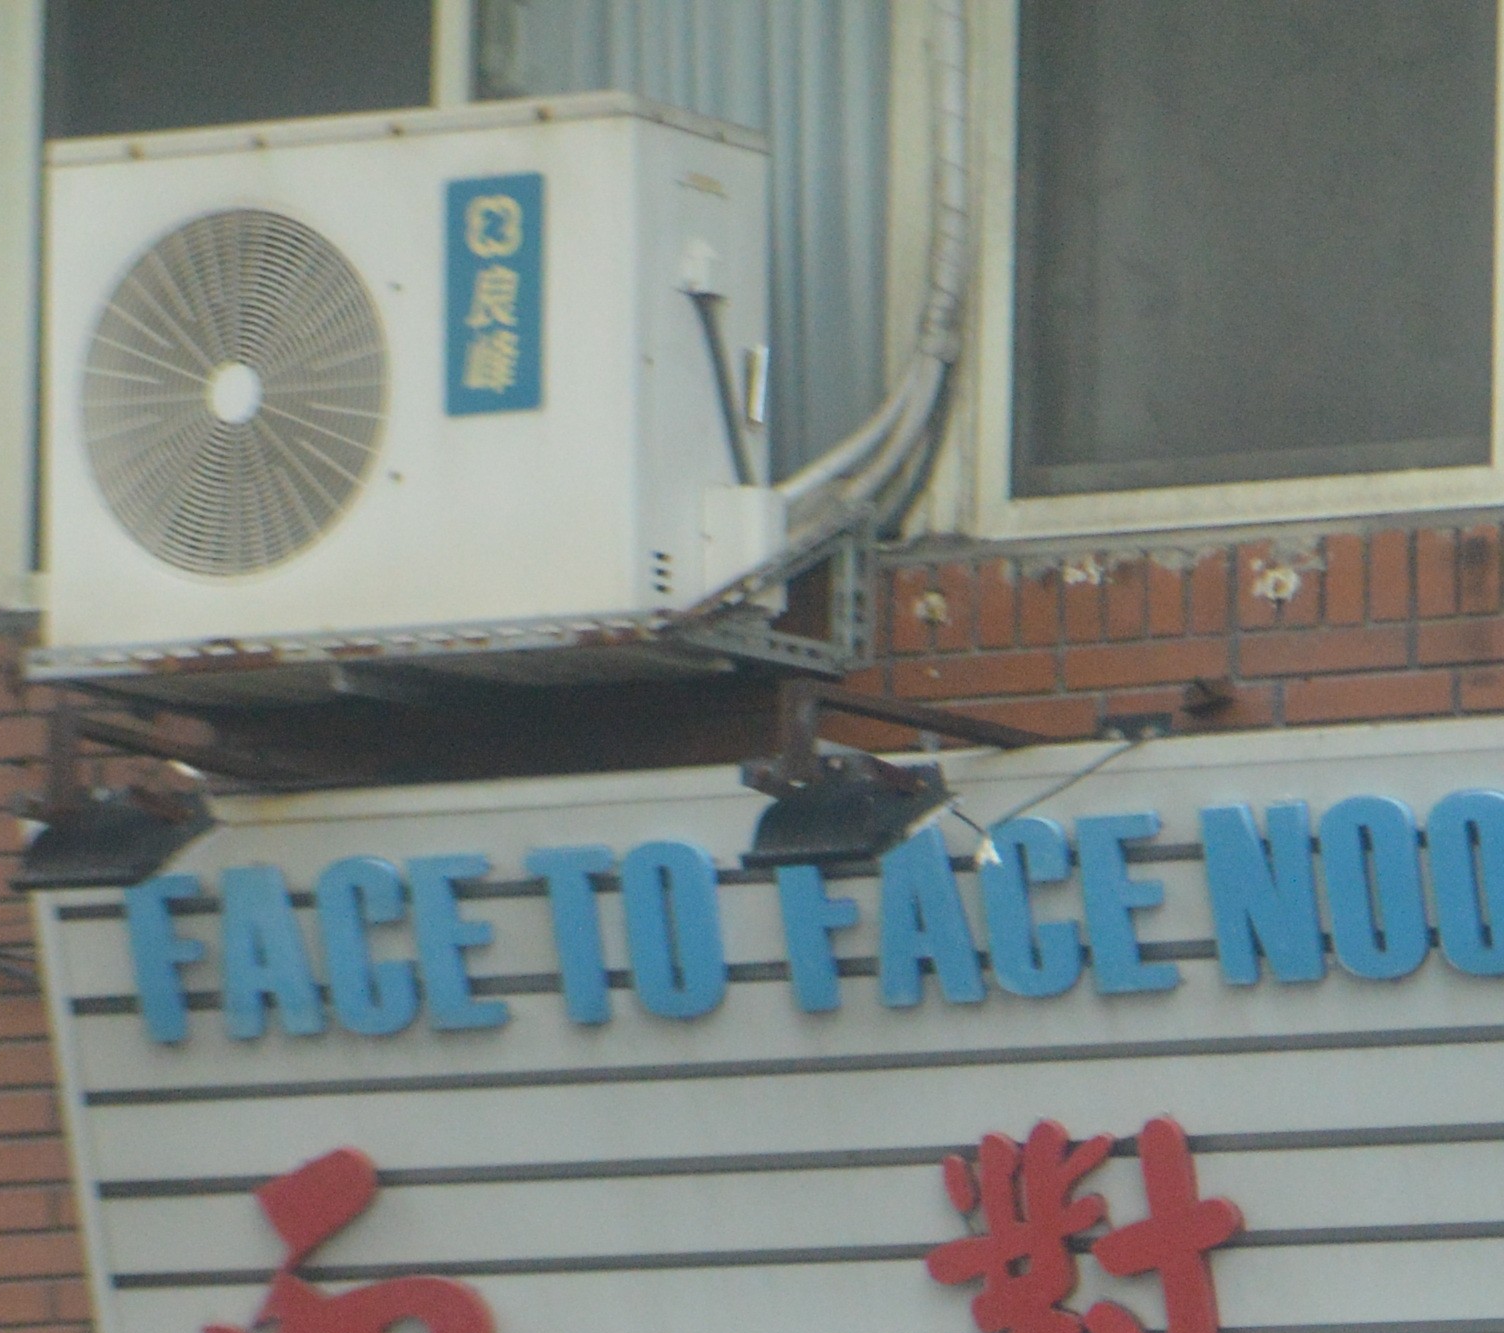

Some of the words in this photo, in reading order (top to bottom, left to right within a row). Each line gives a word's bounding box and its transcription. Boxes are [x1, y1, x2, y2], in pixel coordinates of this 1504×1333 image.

[125, 850, 509, 1045] FACE
[524, 840, 728, 1027] TO
[775, 808, 1182, 1013] FACE
